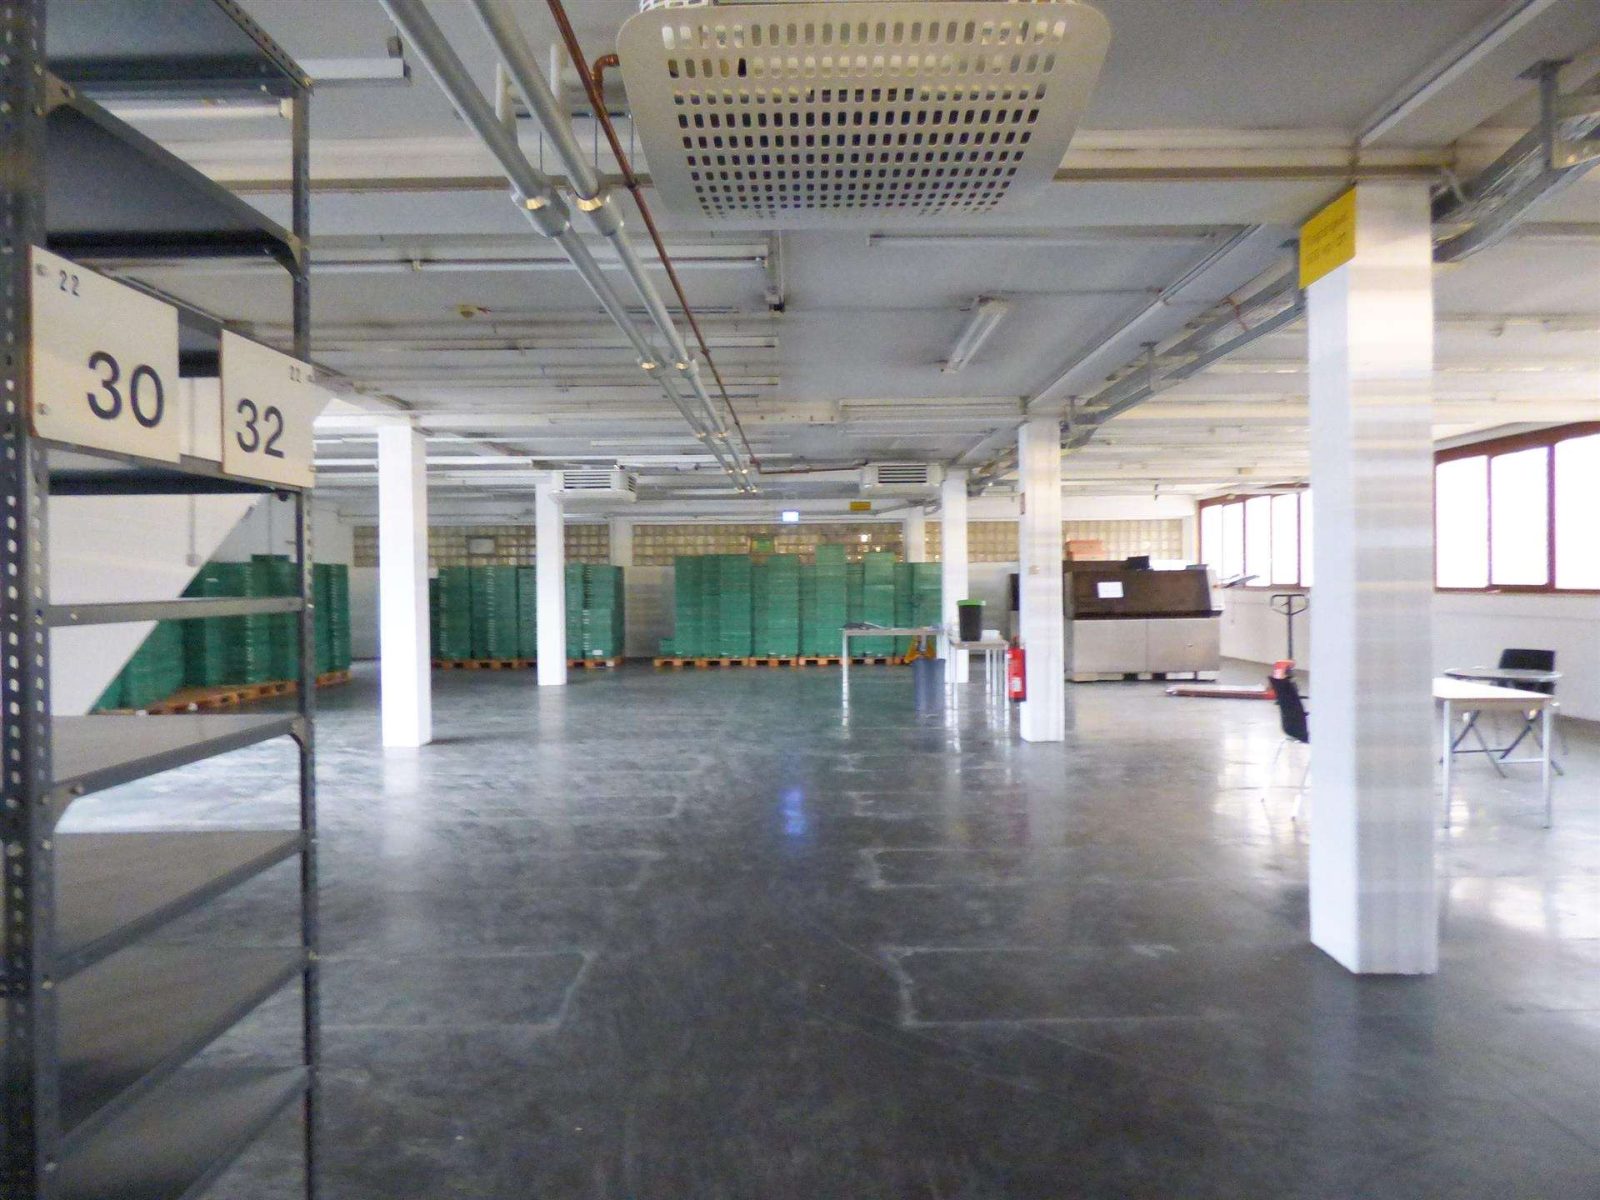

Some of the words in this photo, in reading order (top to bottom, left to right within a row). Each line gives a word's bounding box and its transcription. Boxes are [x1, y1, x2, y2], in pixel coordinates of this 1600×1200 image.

[59, 270, 80, 296] 22
[86, 350, 165, 429] 30
[236, 398, 285, 459] 32
